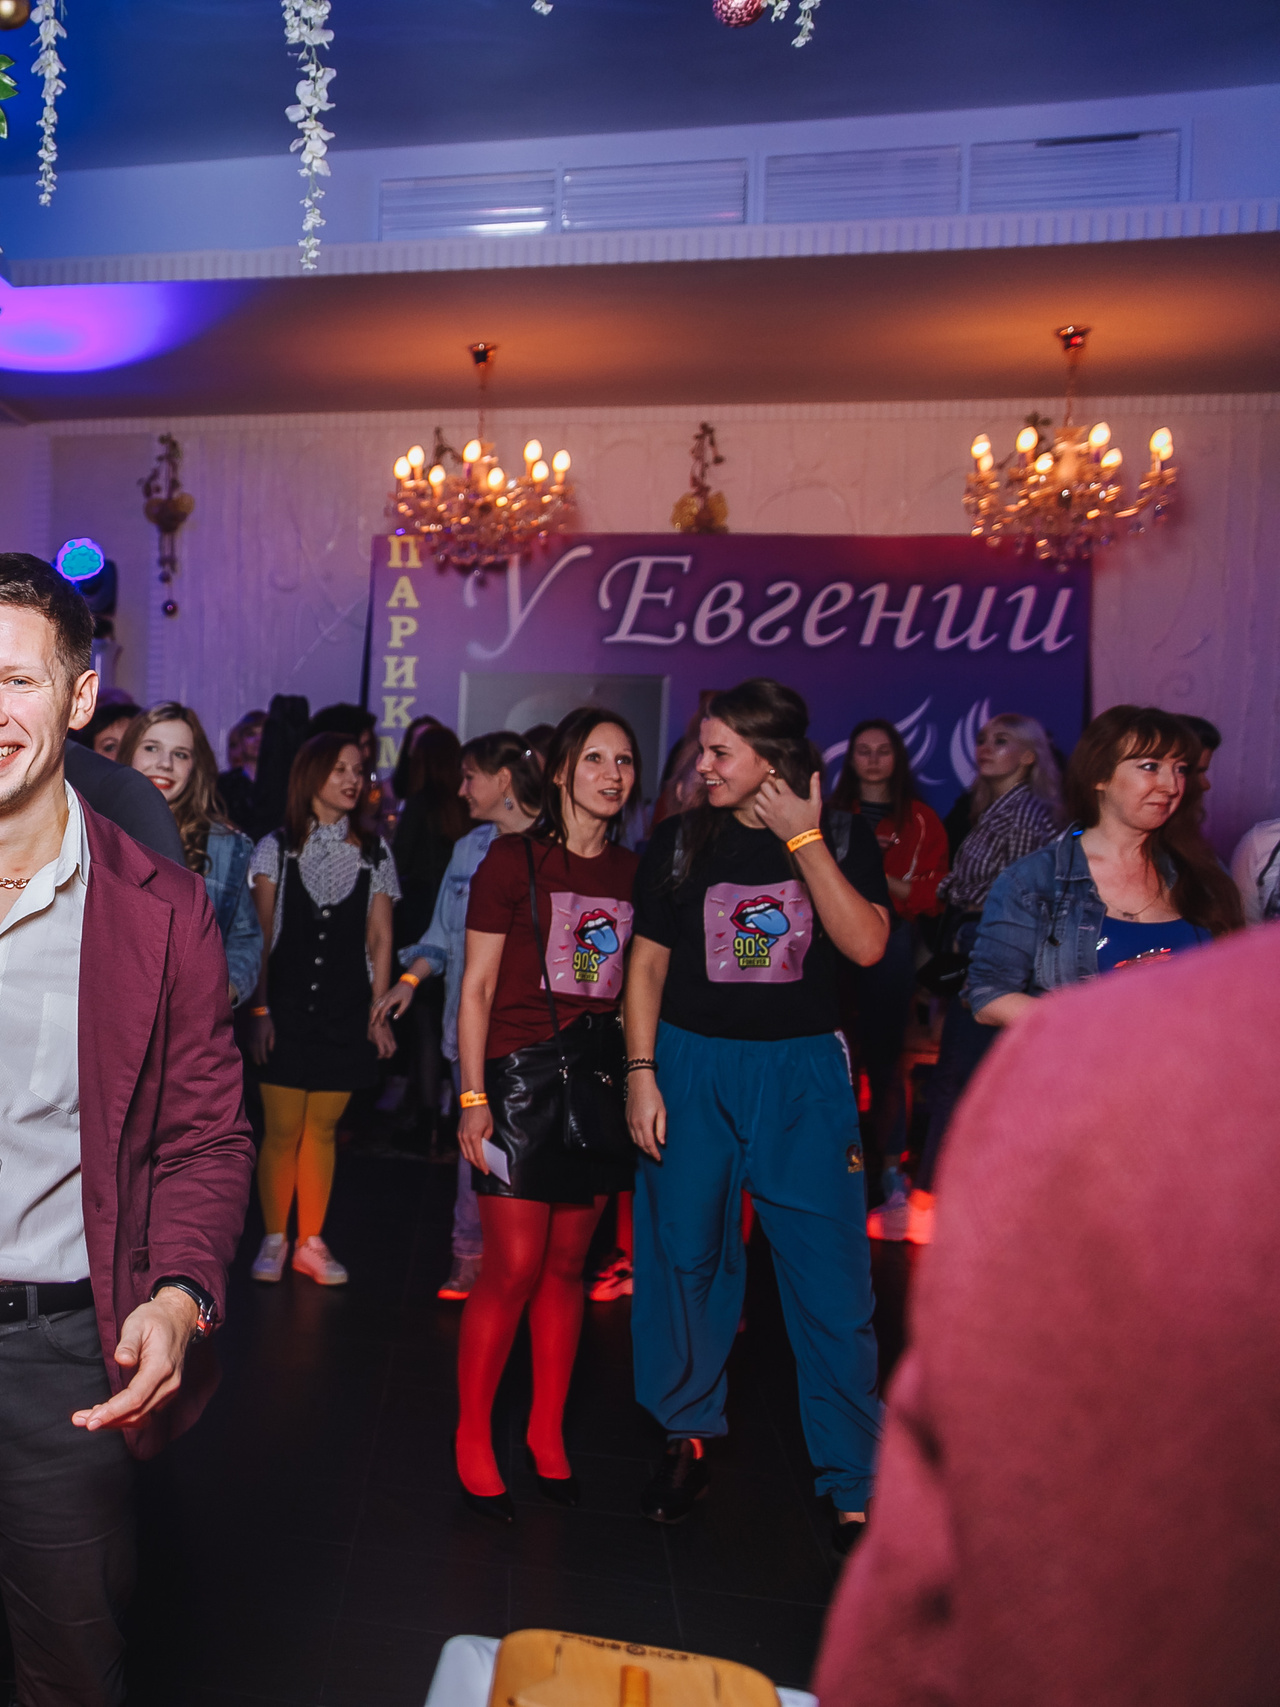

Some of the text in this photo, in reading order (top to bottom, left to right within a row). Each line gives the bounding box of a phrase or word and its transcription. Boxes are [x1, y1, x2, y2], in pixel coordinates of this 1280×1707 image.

[463, 544, 1075, 661] У Евгении
[734, 933, 769, 957] 90'S
[573, 949, 600, 972] 90'S
